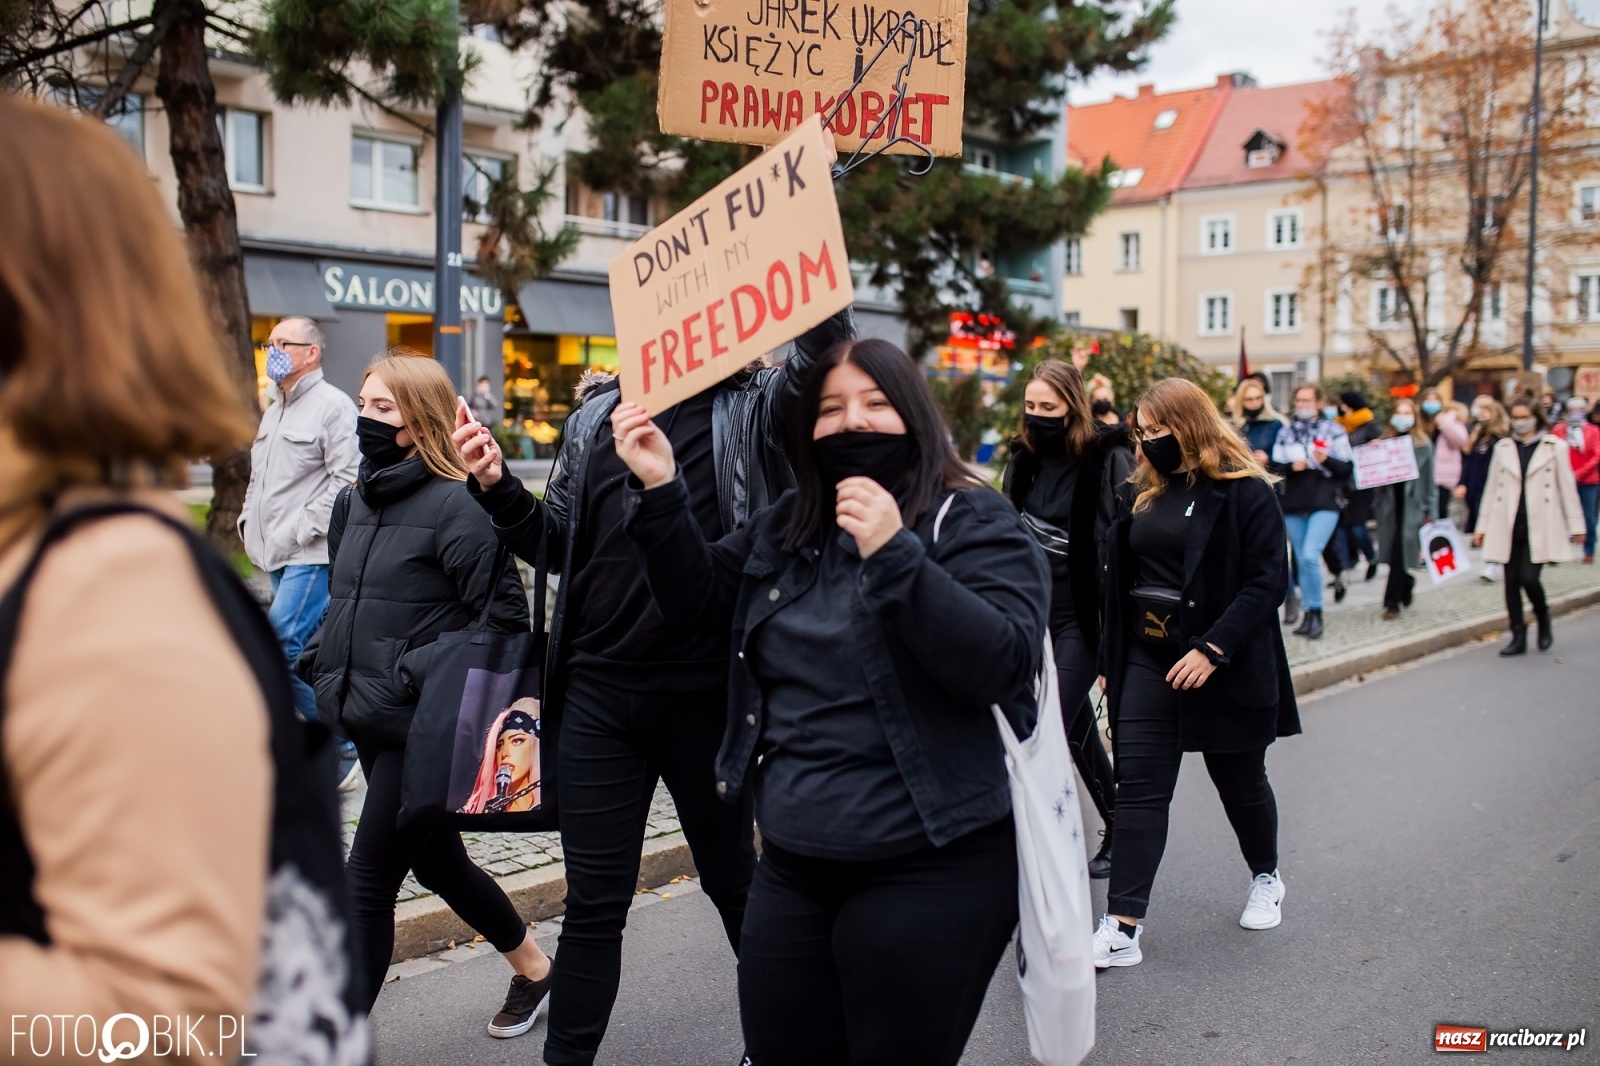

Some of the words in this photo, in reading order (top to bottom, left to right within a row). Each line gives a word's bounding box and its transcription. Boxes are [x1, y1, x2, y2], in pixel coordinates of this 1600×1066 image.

[700, 79, 804, 132] PRAWA
[633, 207, 710, 288] DON'T
[723, 234, 751, 272] MY
[640, 239, 838, 394] FREEDOM
